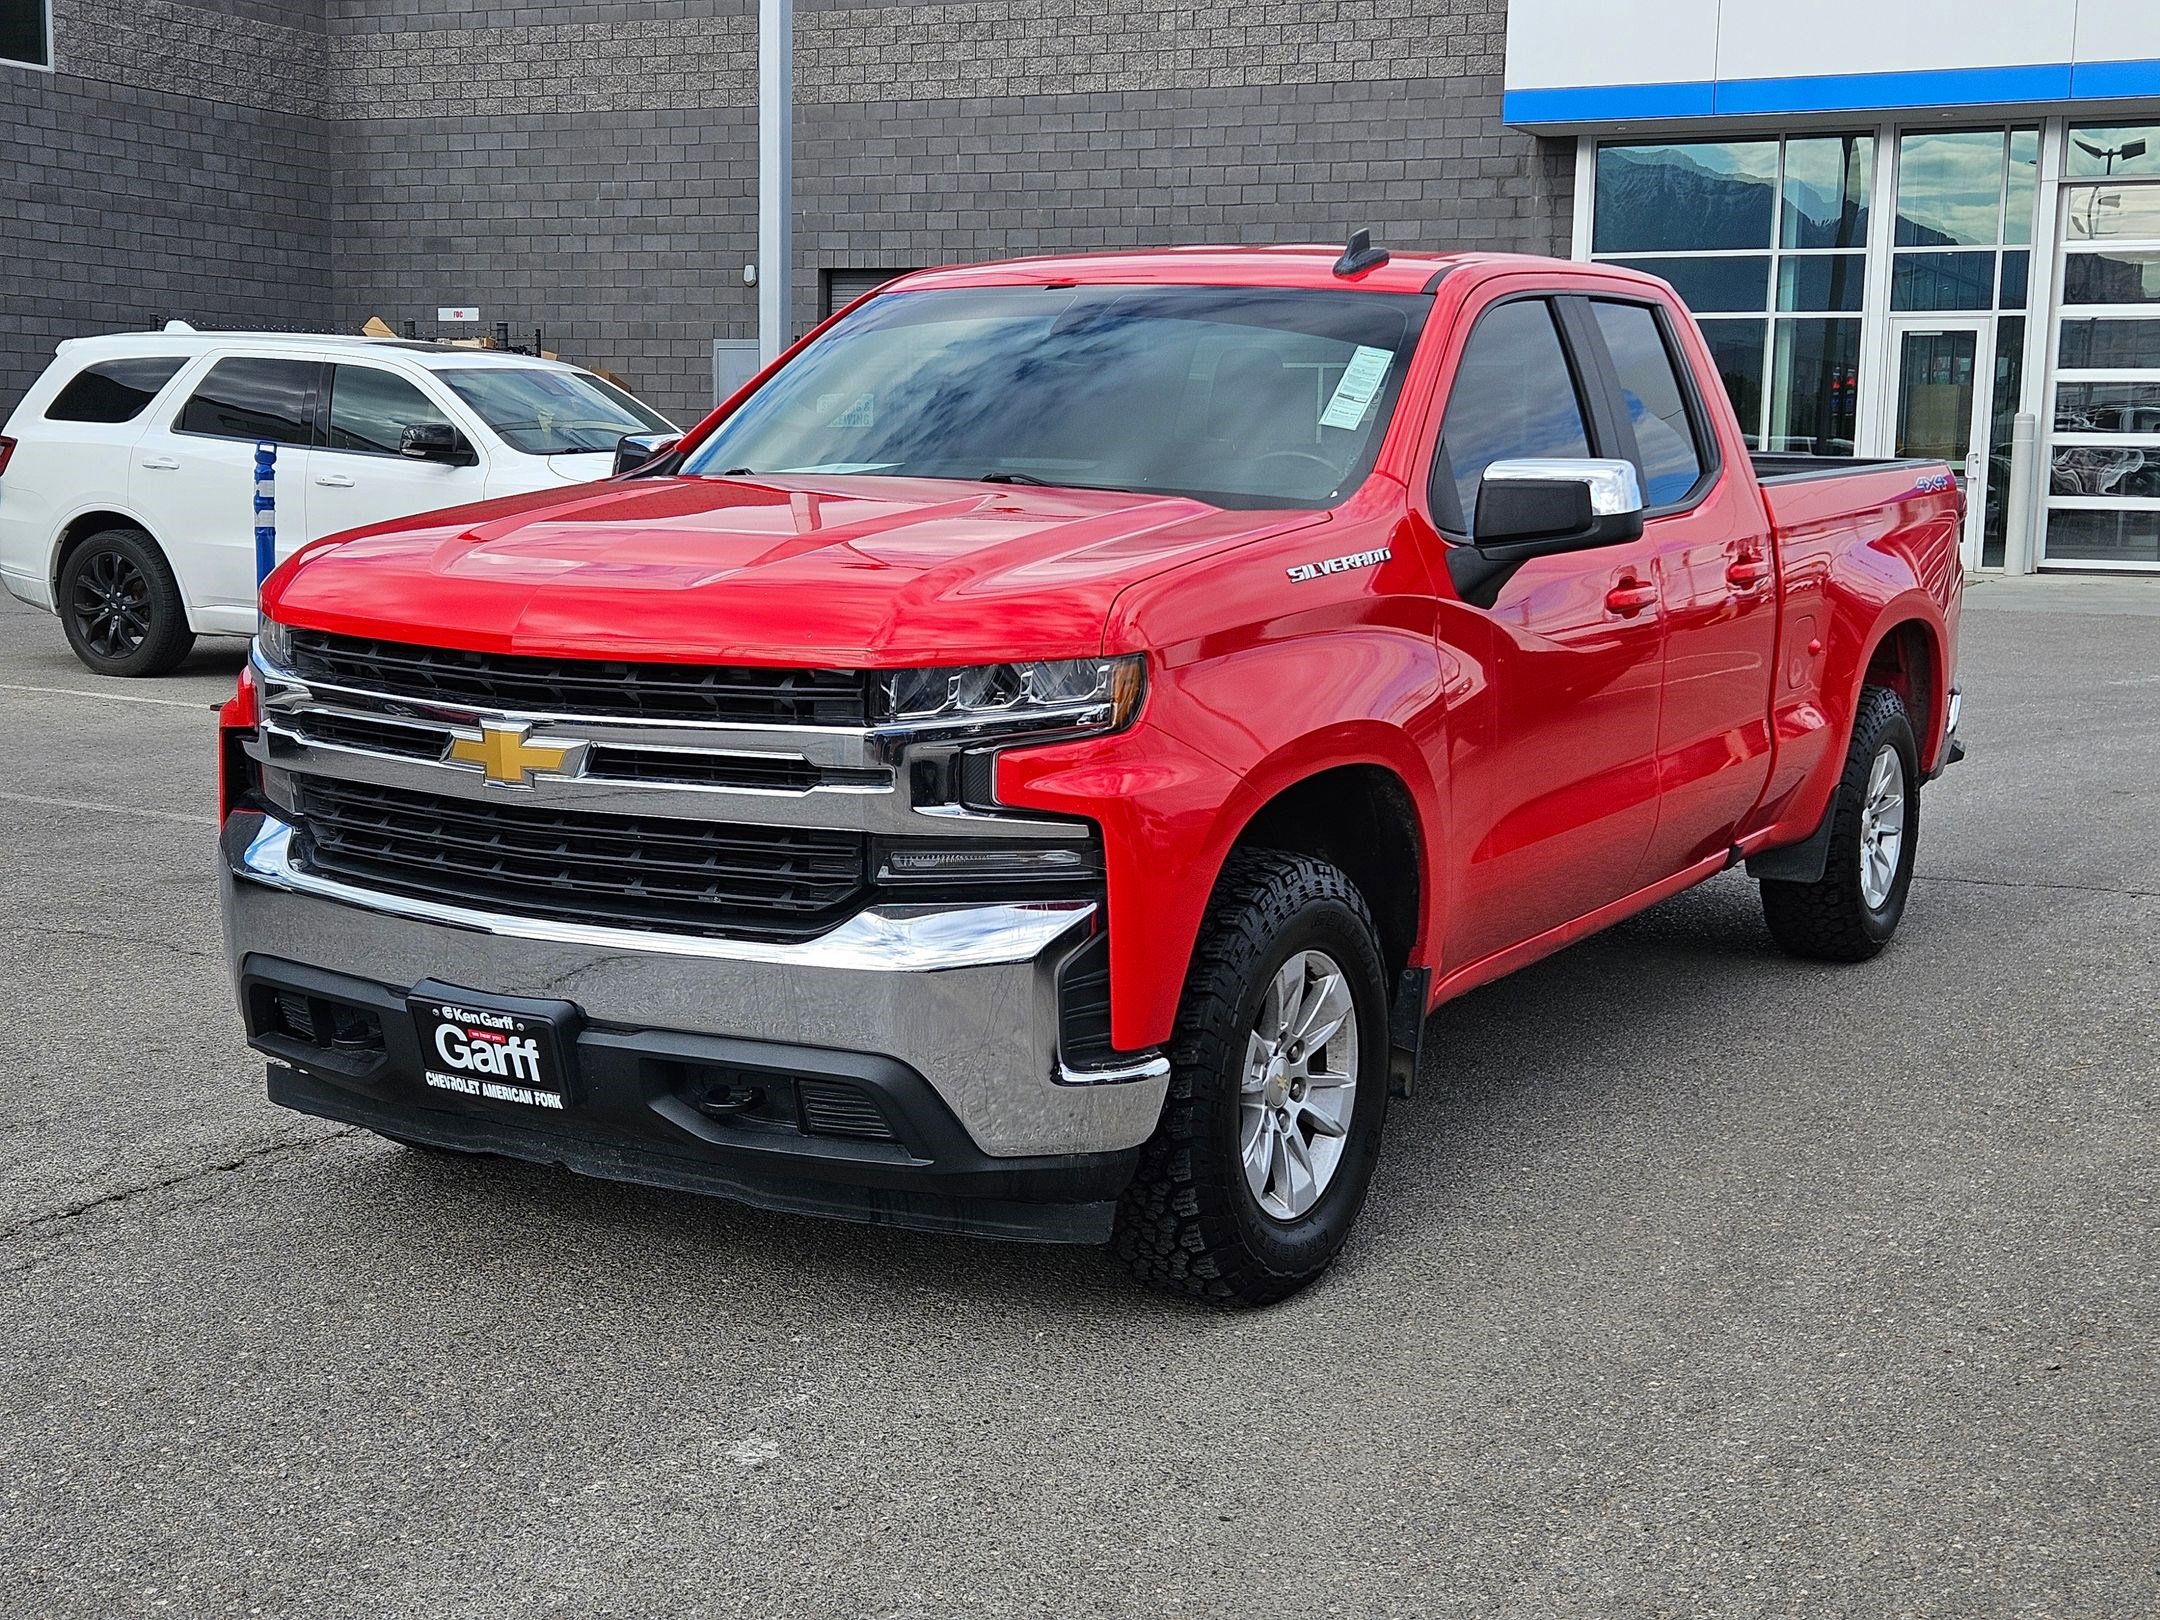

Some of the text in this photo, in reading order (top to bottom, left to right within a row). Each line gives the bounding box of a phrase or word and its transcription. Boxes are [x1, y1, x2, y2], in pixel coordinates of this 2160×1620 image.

[1286, 547, 1392, 583] SILVERADO
[453, 1007, 514, 1030] Ken Garff
[435, 1023, 541, 1082] Garff
[425, 1071, 564, 1110] CHEVROLET AMERICAN FORK
